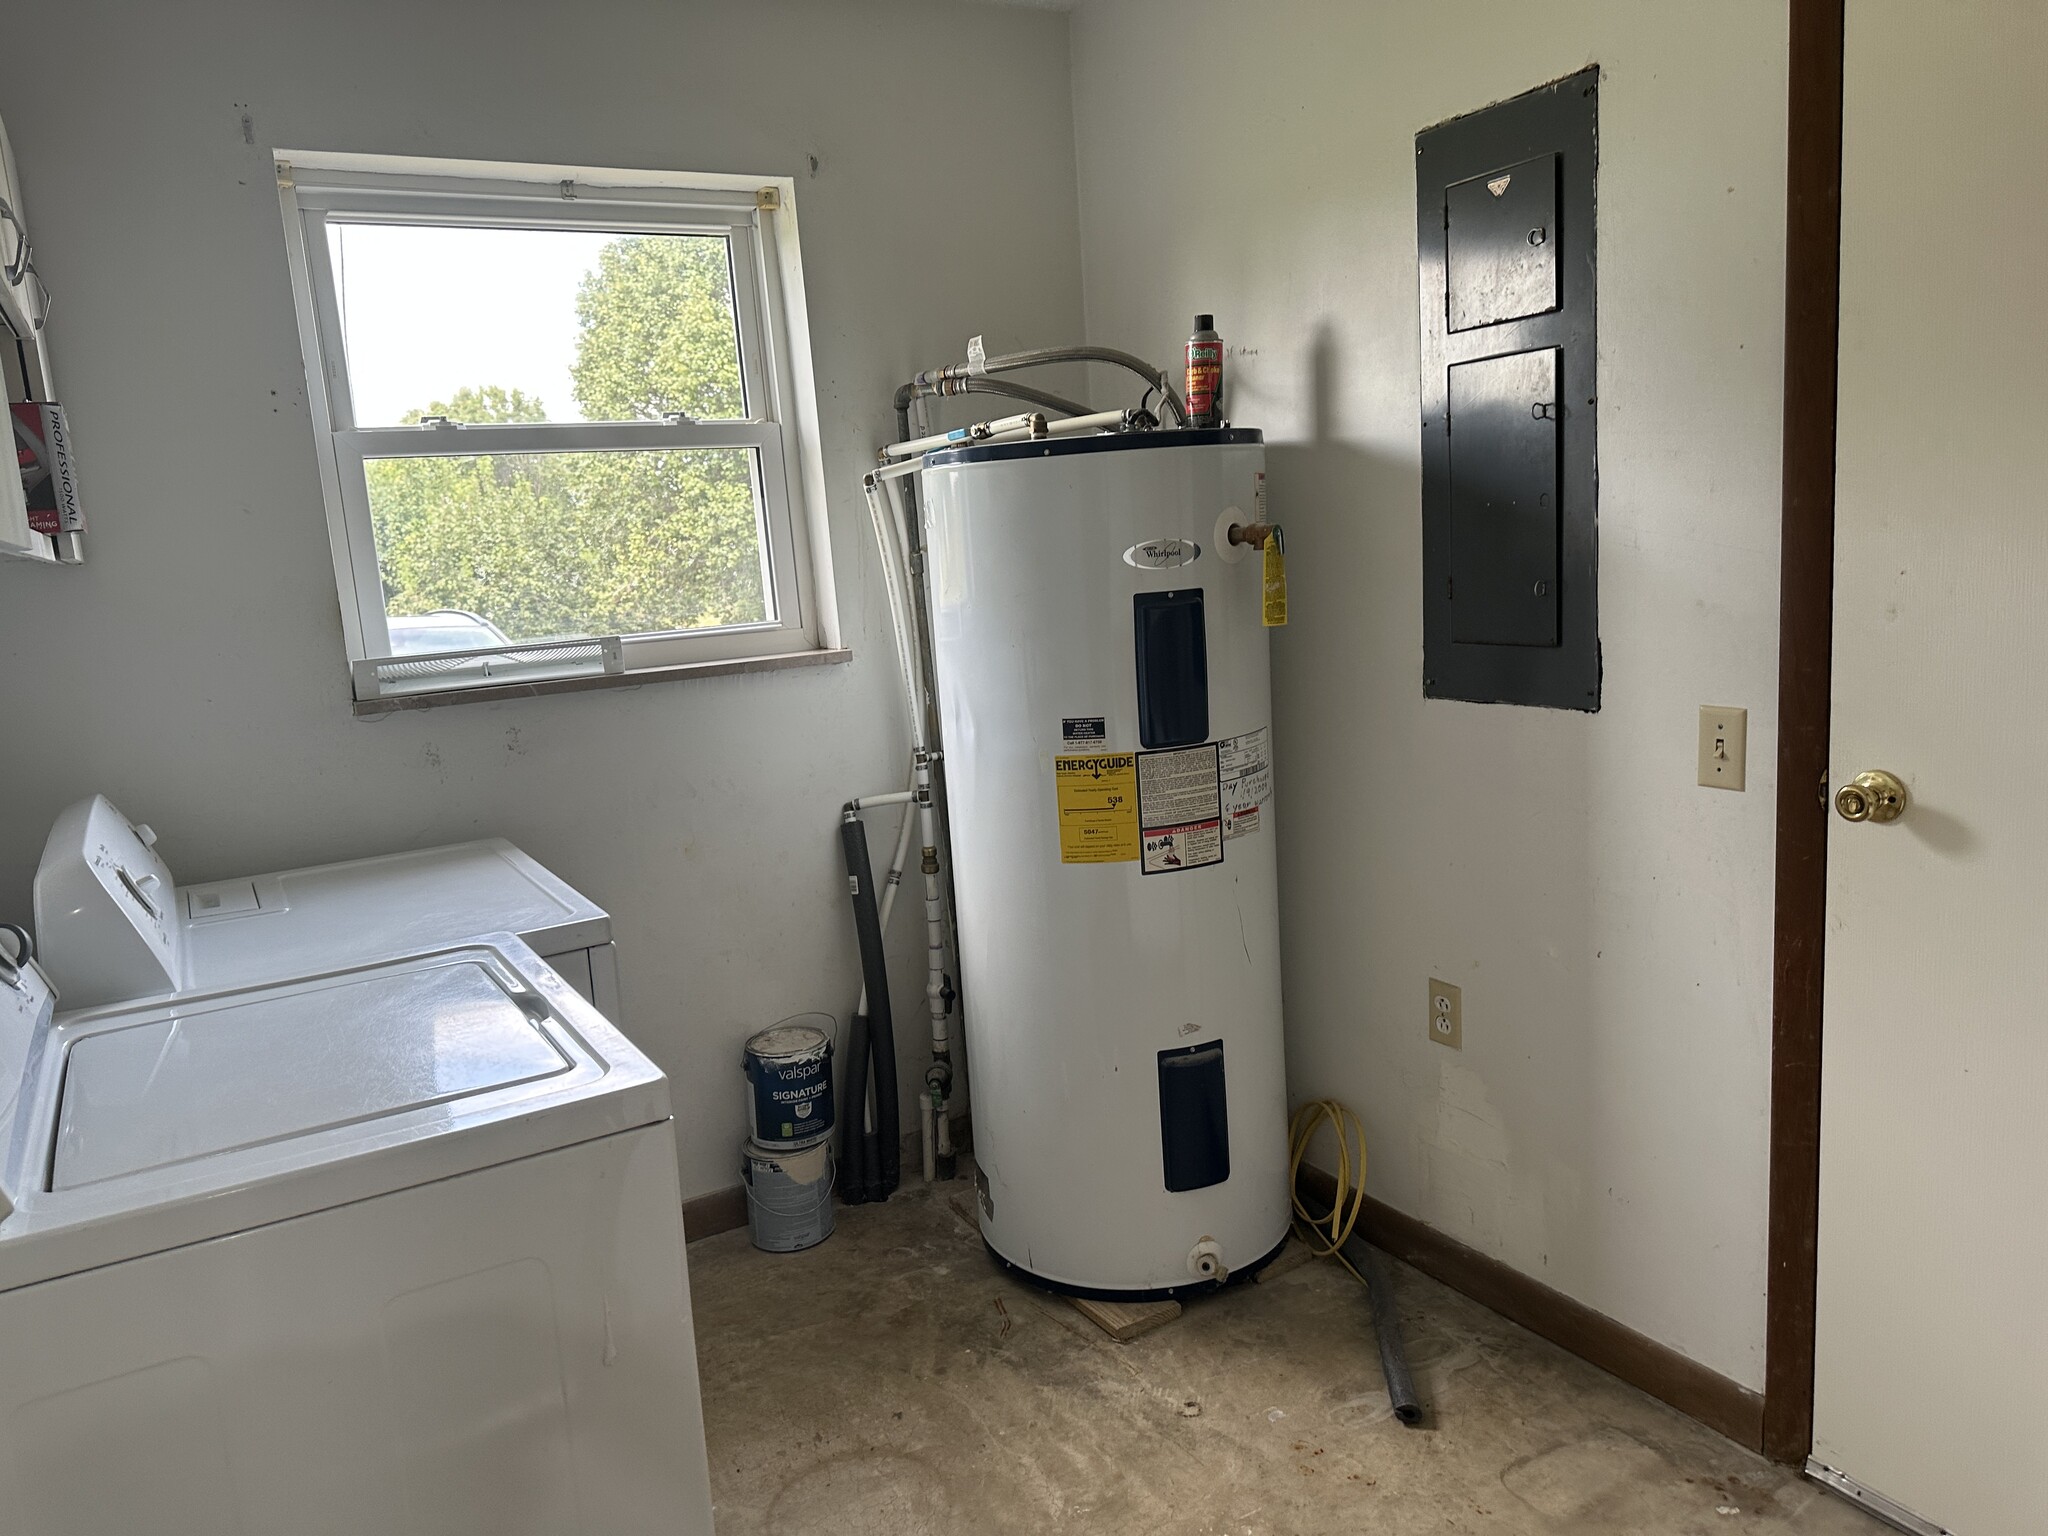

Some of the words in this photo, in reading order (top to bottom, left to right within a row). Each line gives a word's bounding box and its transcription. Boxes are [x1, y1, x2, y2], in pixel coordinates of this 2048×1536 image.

[1188, 347, 1217, 361] O'Reilly
[1187, 367, 1198, 376] Crb
[50, 411, 78, 524] PROFESSIONAL
[30, 521, 58, 529] AMING
[1146, 549, 1181, 559] Whirlpool
[1055, 756, 1134, 771] ENERGYGUIDE
[1222, 781, 1238, 796] Day
[1176, 825, 1202, 833] DANGER
[778, 1062, 822, 1080] valspar
[772, 1080, 828, 1100] SIGNATURE
